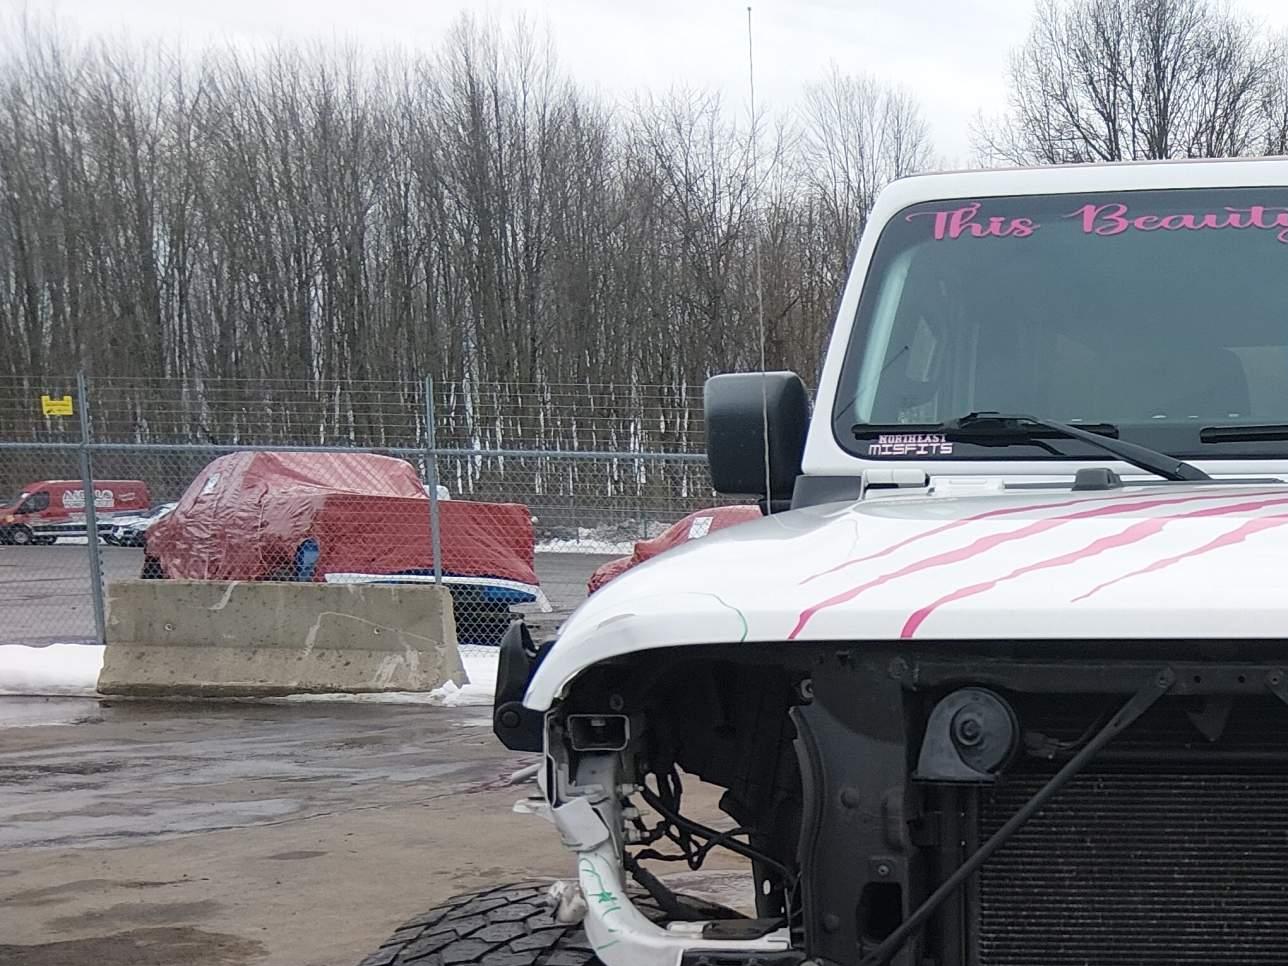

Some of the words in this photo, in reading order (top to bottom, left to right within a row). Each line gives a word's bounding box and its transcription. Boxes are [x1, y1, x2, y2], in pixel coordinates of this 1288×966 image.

[905, 202, 1041, 241] This
[879, 433, 947, 444] NORTHEAST
[868, 443, 953, 456] MISFITS
